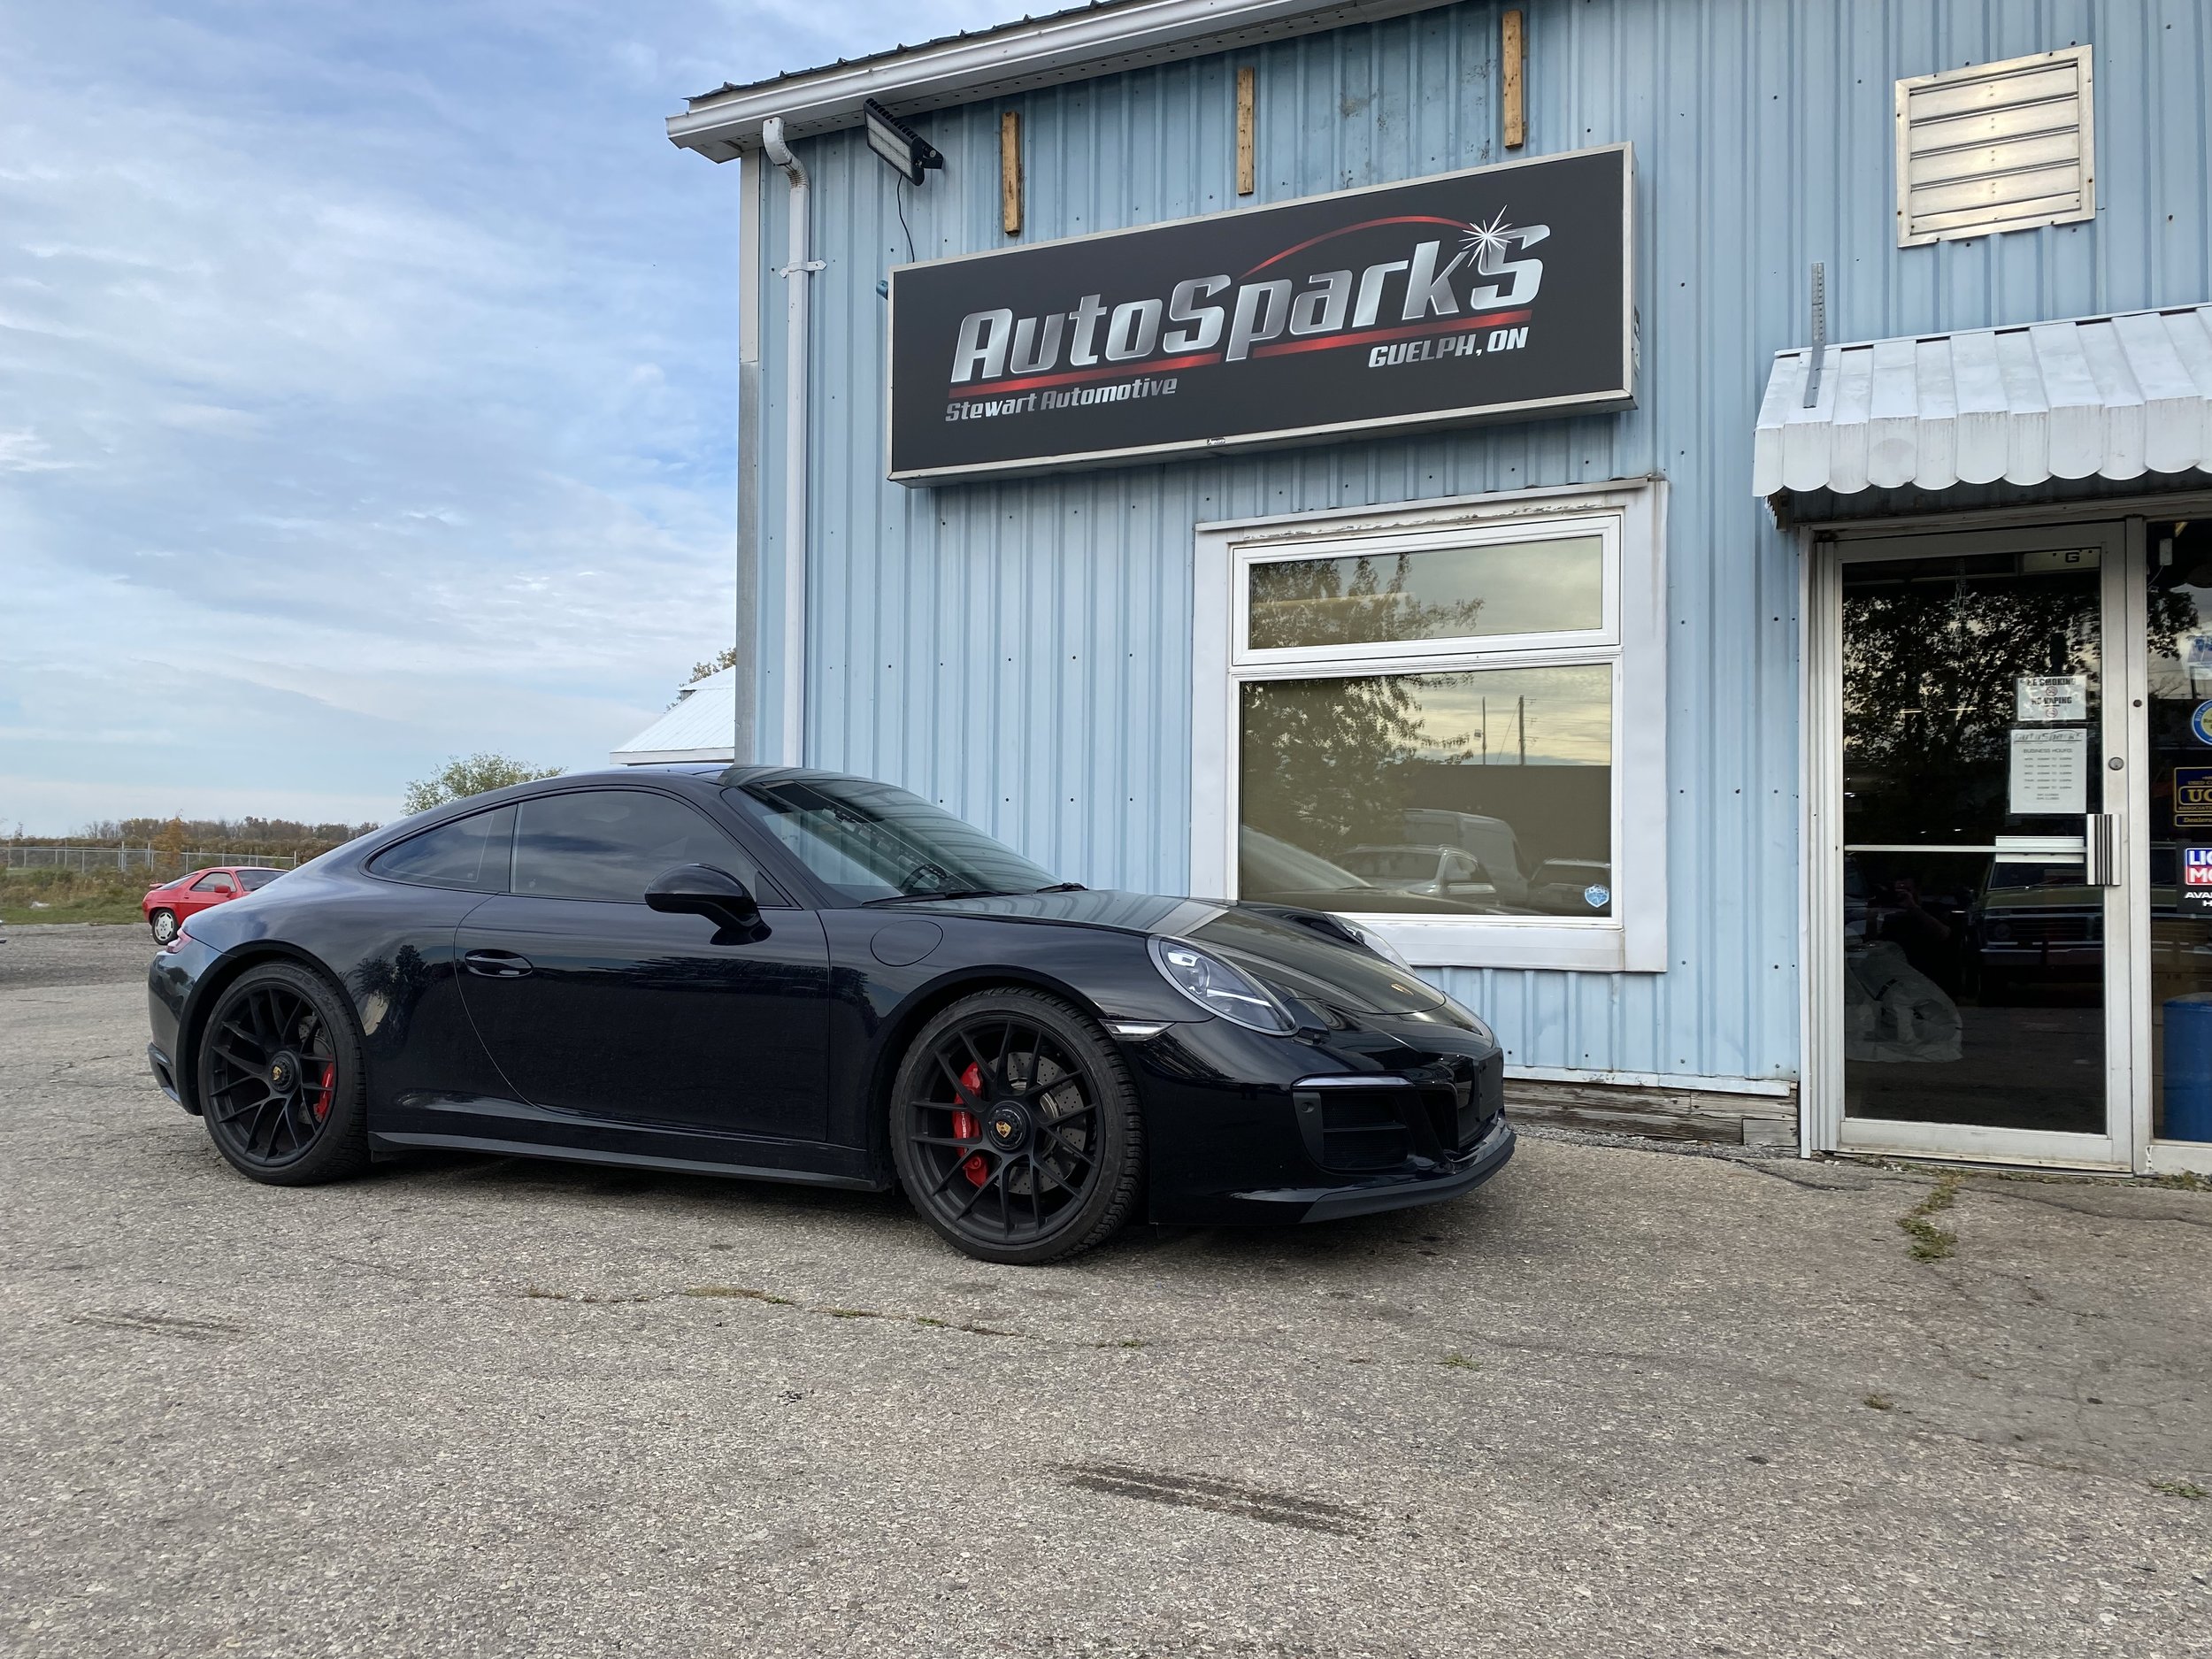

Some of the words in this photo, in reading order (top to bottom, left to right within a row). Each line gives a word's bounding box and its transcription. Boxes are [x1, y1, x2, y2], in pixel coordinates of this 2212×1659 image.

[1486, 326, 1530, 353] ON
[944, 393, 1038, 422] Stewart
[1040, 377, 1179, 411] Automotive
